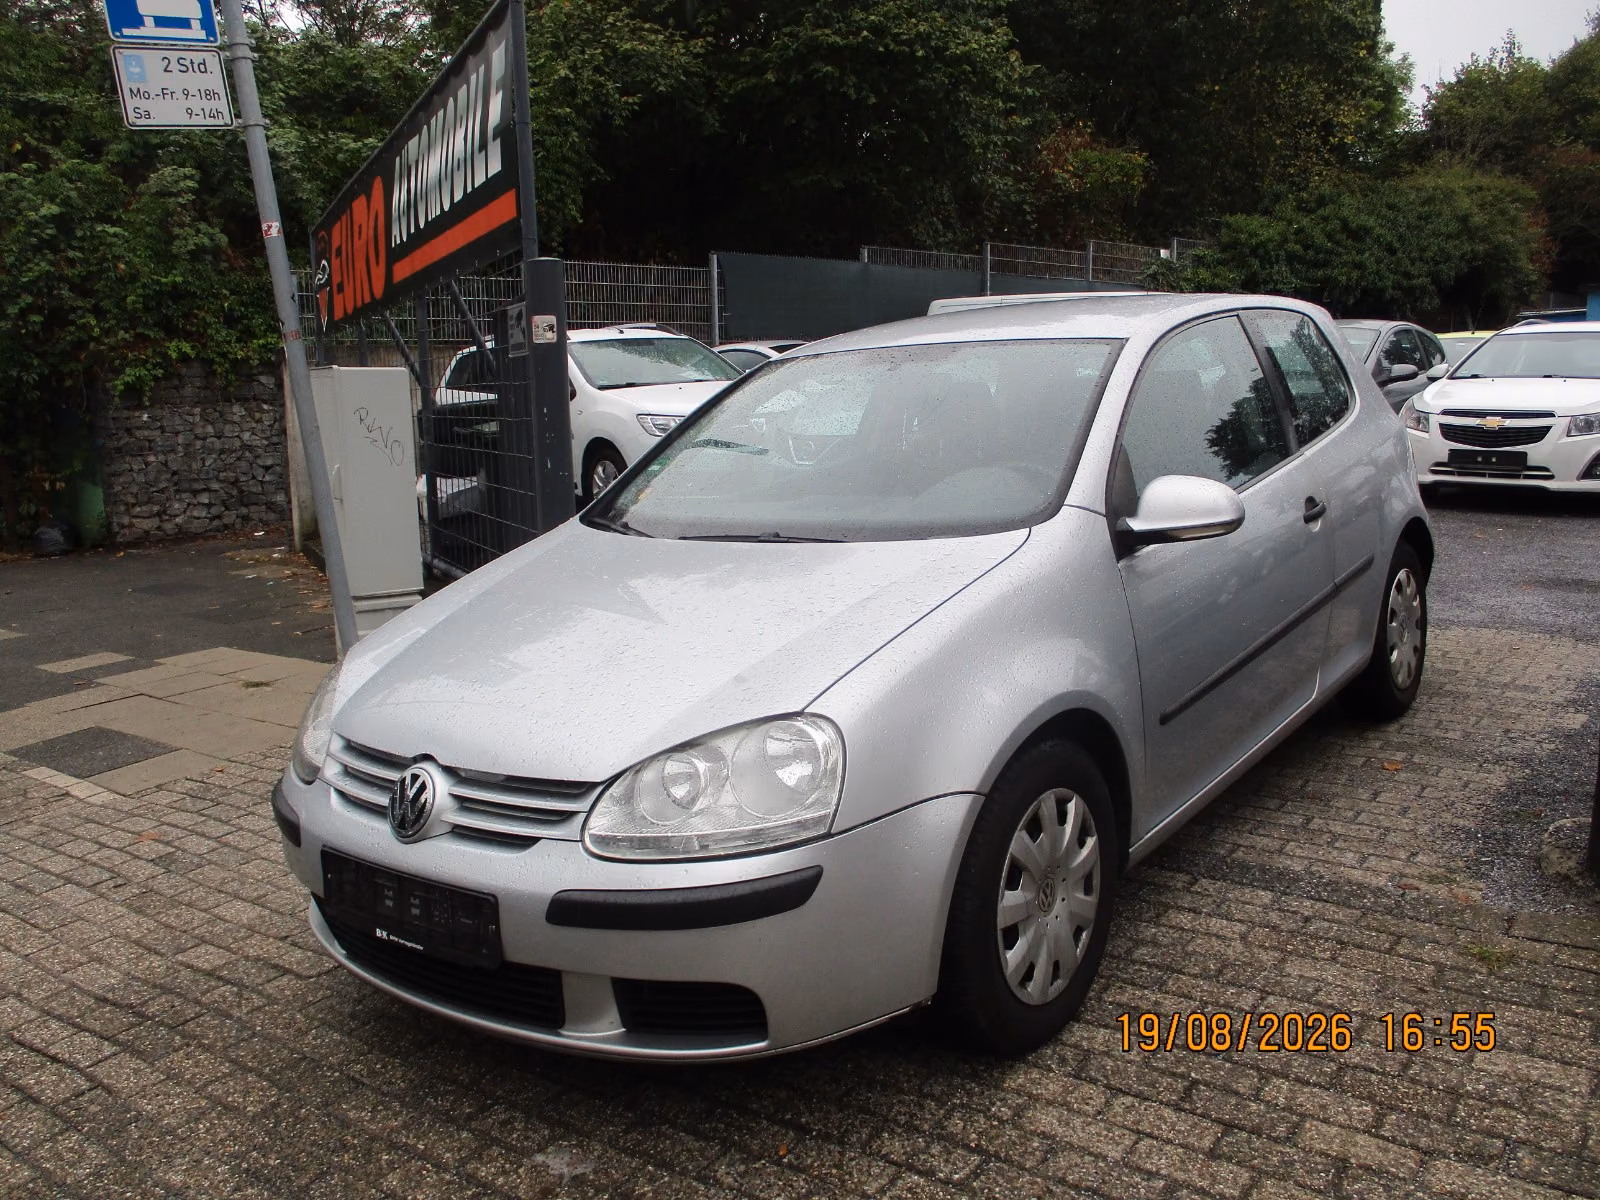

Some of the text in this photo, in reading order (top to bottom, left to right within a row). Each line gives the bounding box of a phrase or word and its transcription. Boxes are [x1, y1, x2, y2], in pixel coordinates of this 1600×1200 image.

[161, 57, 213, 74] 2 Std.
[128, 87, 221, 101] Mo.-Fr. 9-18h
[132, 106, 225, 120] Sa. 9-14h
[331, 39, 507, 321] EURO AUTOMOBILE
